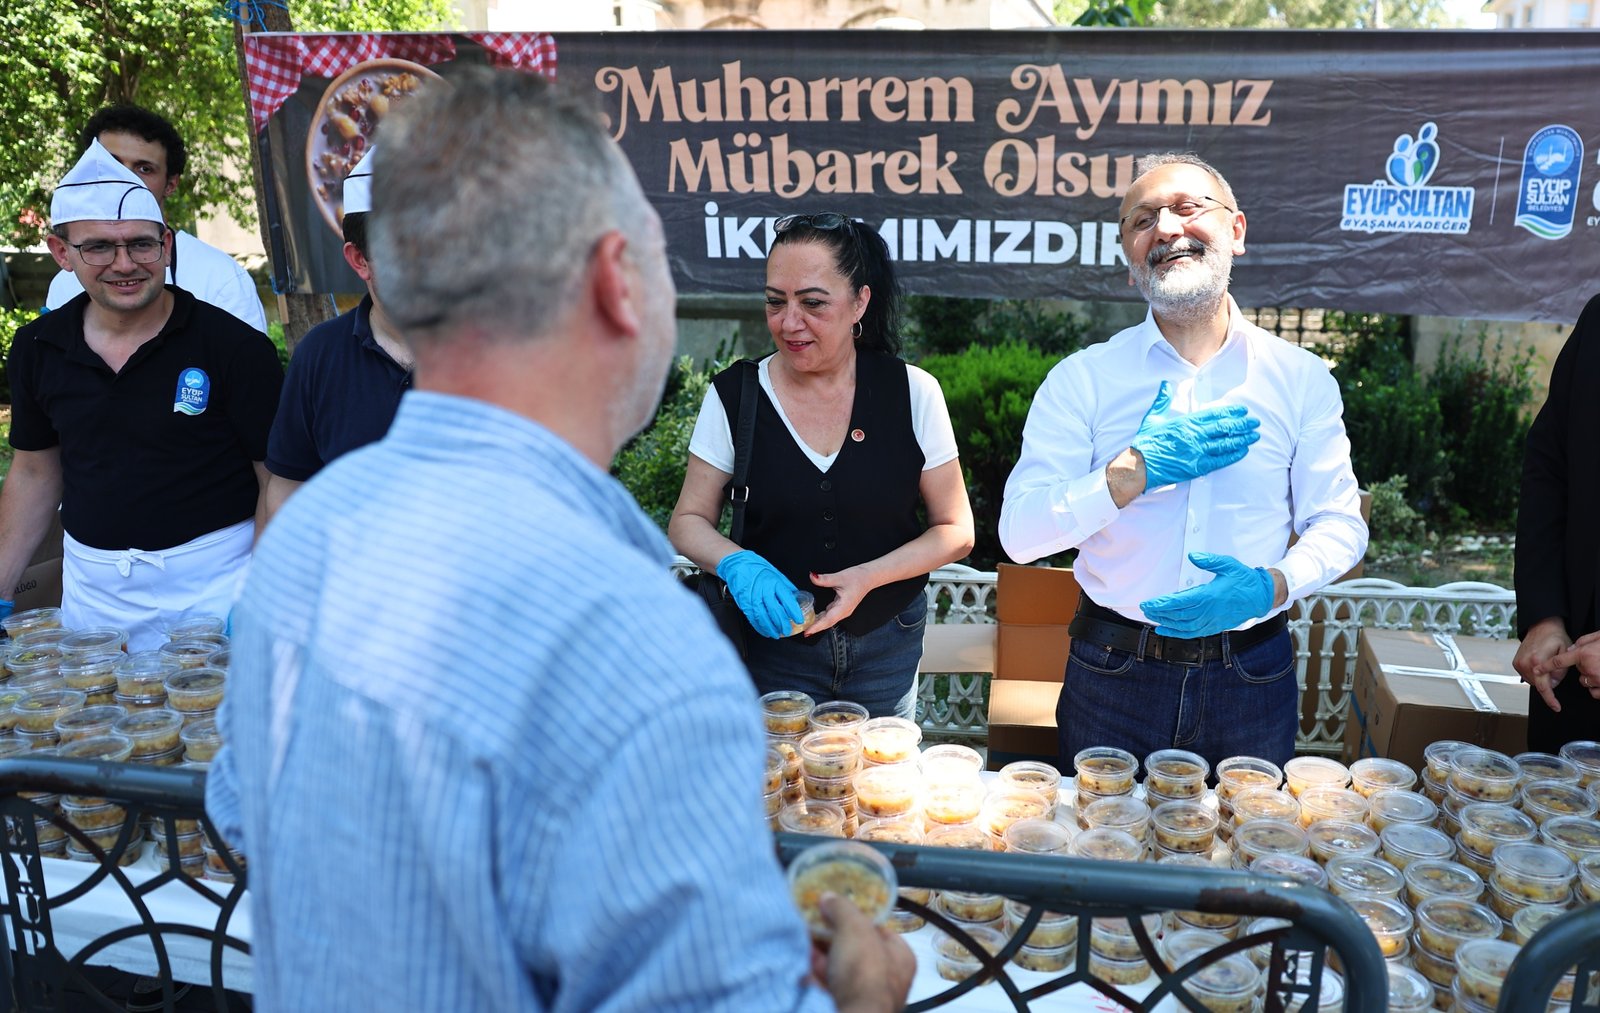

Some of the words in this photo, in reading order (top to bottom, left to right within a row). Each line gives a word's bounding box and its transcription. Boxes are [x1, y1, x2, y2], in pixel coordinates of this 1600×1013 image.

[595, 60, 975, 142] Muharrem
[996, 63, 1274, 140] Ayımız
[668, 132, 963, 198] Mübarek
[984, 135, 1138, 198] Olsu
[1527, 178, 1572, 194] EYÜP
[1346, 183, 1471, 218] EYÜPSULTAN
[1525, 193, 1570, 206] SULTAN
[1343, 219, 1468, 232] #YAŞAMAYADEĞER
